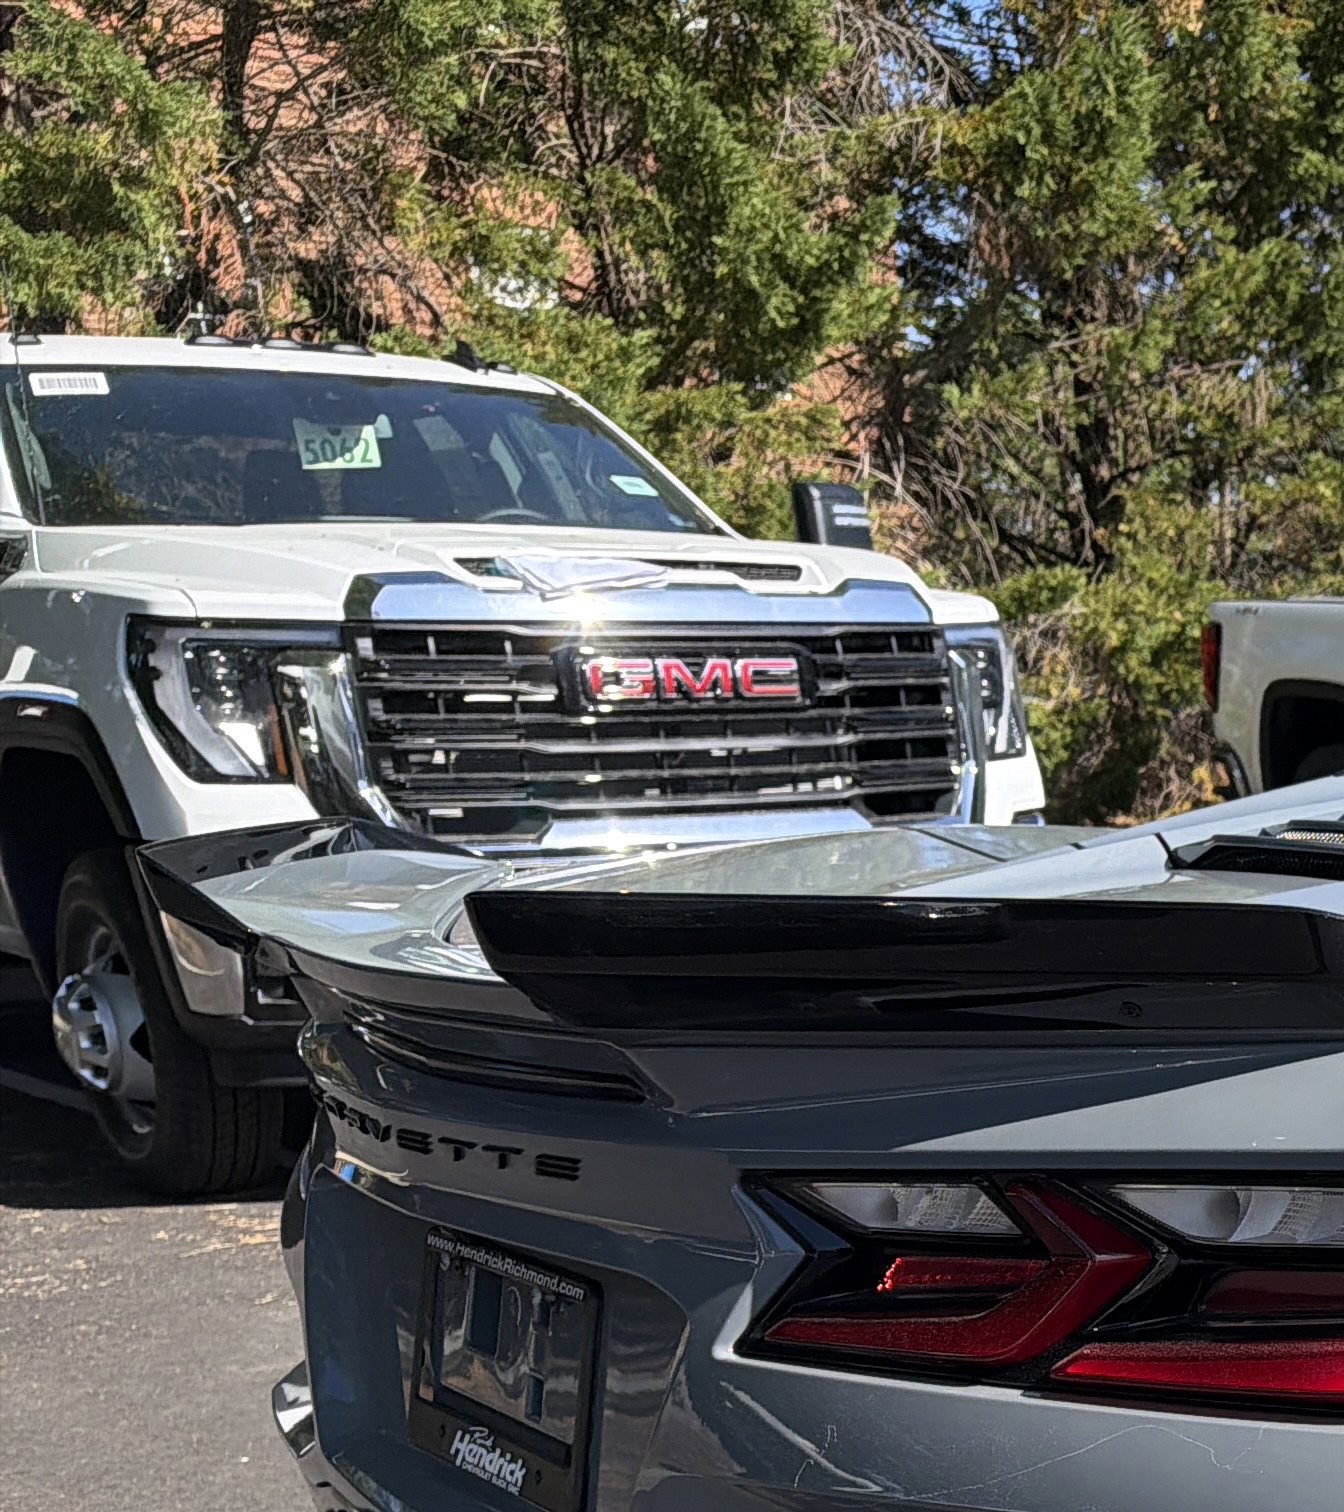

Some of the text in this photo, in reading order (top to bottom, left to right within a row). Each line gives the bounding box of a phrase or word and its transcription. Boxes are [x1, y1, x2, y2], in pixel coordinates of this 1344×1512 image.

[303, 437, 374, 464] 5062
[586, 657, 800, 699] GMC
[312, 1084, 582, 1181] ORVETTE
[427, 1232, 585, 1301] www.HendrickRichmond.com
[450, 1429, 527, 1488] Hendrick
